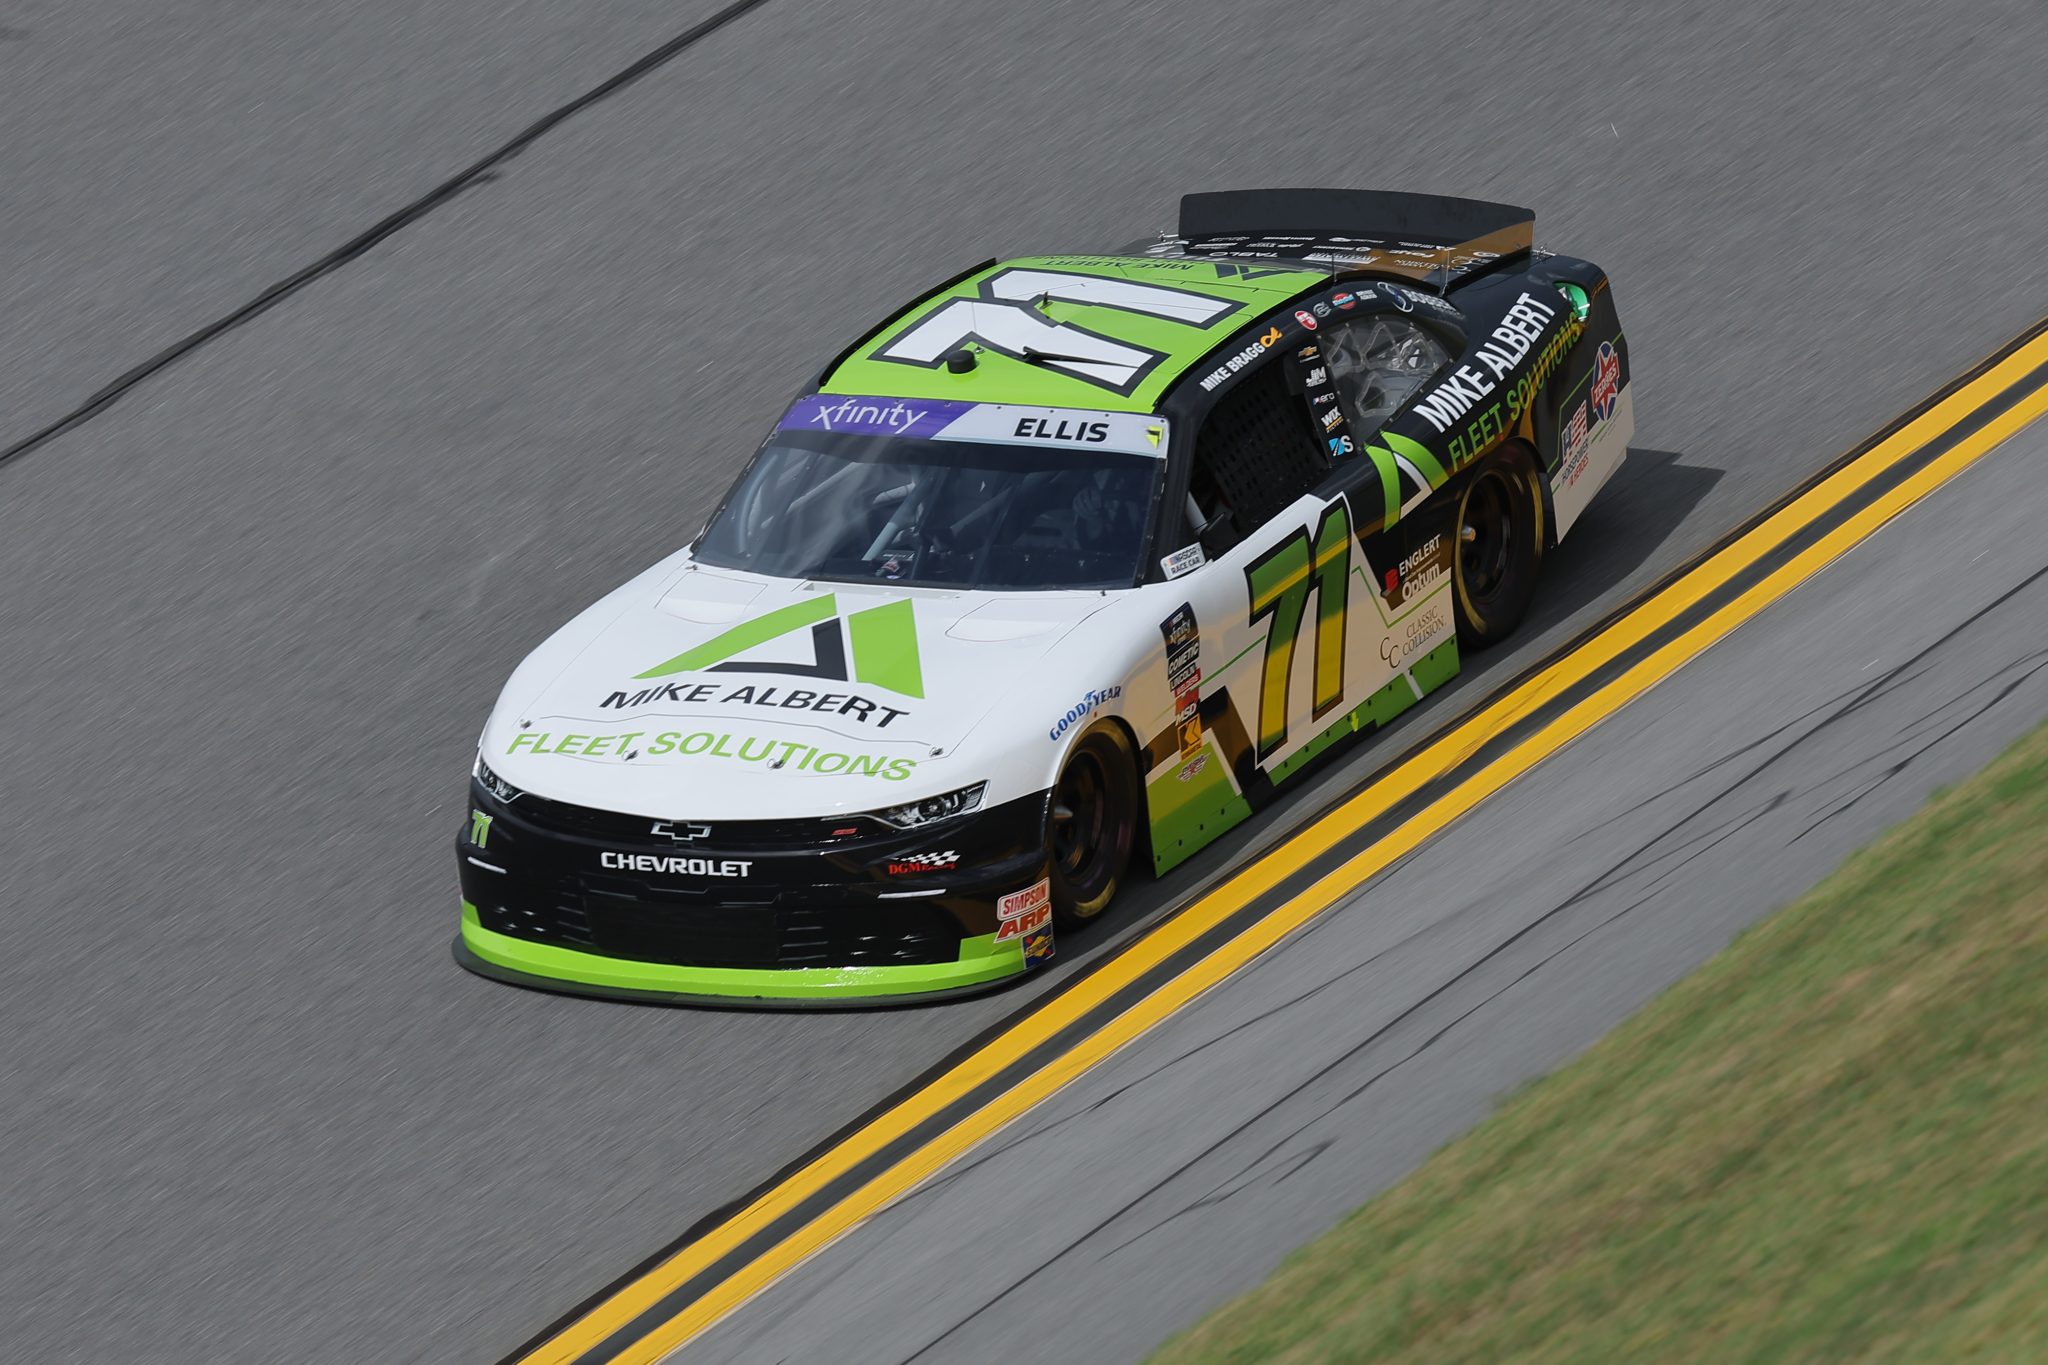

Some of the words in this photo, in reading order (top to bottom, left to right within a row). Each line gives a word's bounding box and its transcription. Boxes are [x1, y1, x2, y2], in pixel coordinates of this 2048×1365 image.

[1200, 366, 1232, 391] MIKE
[1225, 342, 1265, 372] BRAGG
[1413, 365, 1496, 433] MIKE
[1475, 292, 1555, 381] ALBERT
[1448, 403, 1504, 473] FLEET
[1507, 312, 1583, 421] SOLUTIONS
[811, 403, 928, 434] xfinity
[1014, 417, 1109, 443] ELLIS
[1321, 406, 1342, 426] WIX
[1399, 533, 1440, 577] ENGLERT
[1245, 500, 1353, 766] 71
[1402, 615, 1444, 656] COLLISION
[1406, 606, 1439, 639] CLASSIC
[600, 682, 721, 709] MIKE
[720, 685, 910, 728] ALBERT
[1049, 686, 1121, 741] GOODYEAR
[506, 732, 645, 755] FLEET
[648, 731, 917, 781] SOLUTIONS
[470, 809, 493, 848] 71
[601, 852, 752, 877] CHEVROLET
[889, 864, 922, 875] DGM
[1003, 882, 1047, 915] SIMPSON
[997, 902, 1051, 940] ARP
